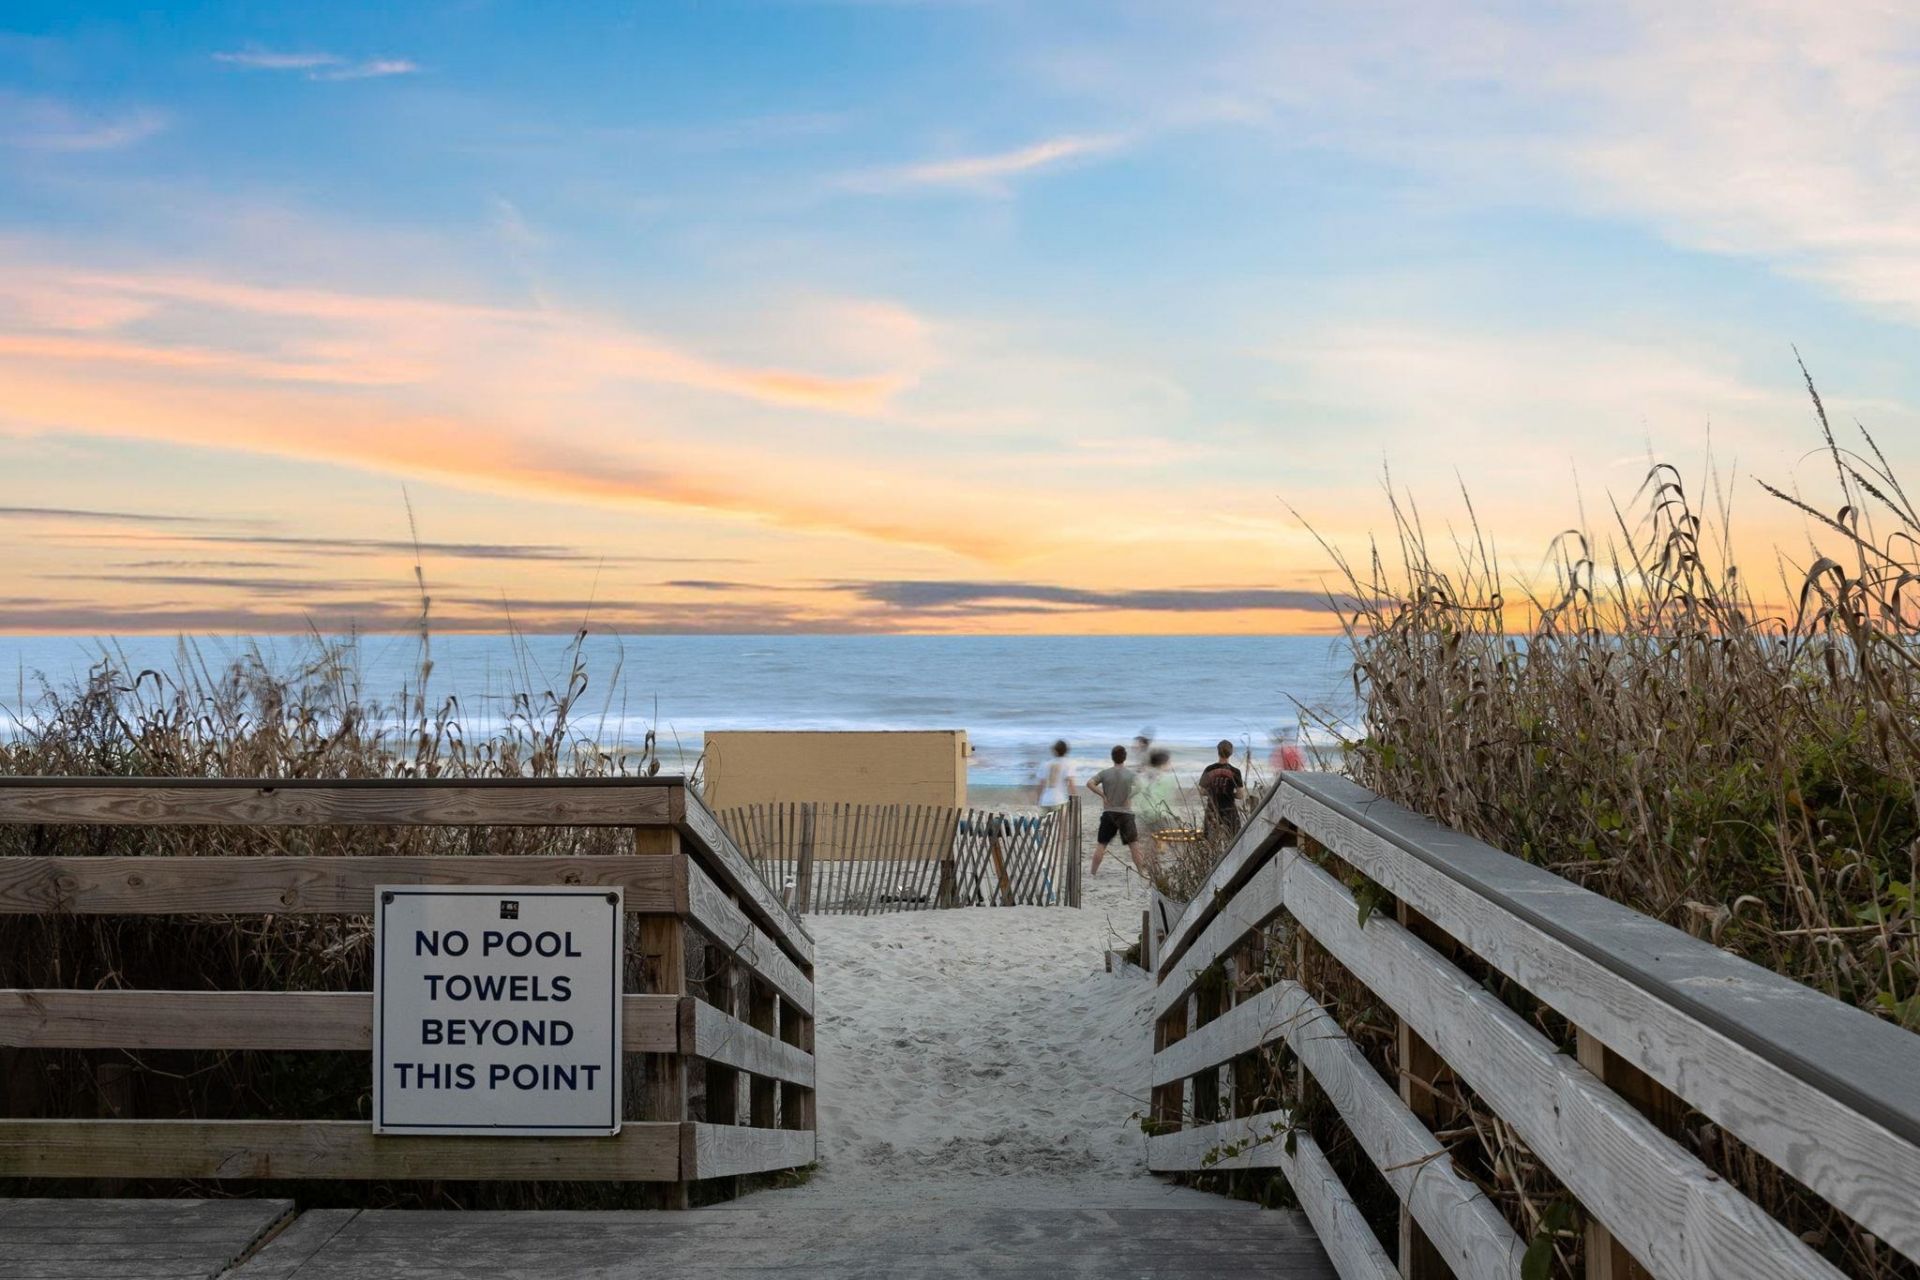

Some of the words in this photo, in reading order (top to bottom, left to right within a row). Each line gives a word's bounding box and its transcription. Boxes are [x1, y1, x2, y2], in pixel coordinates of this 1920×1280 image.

[415, 930, 469, 957] NO
[483, 931, 582, 958] POOL
[424, 974, 572, 1002] TOWELS
[422, 1018, 574, 1046] BEYOND
[393, 1062, 476, 1090] THIS
[489, 1063, 601, 1091] POINT
